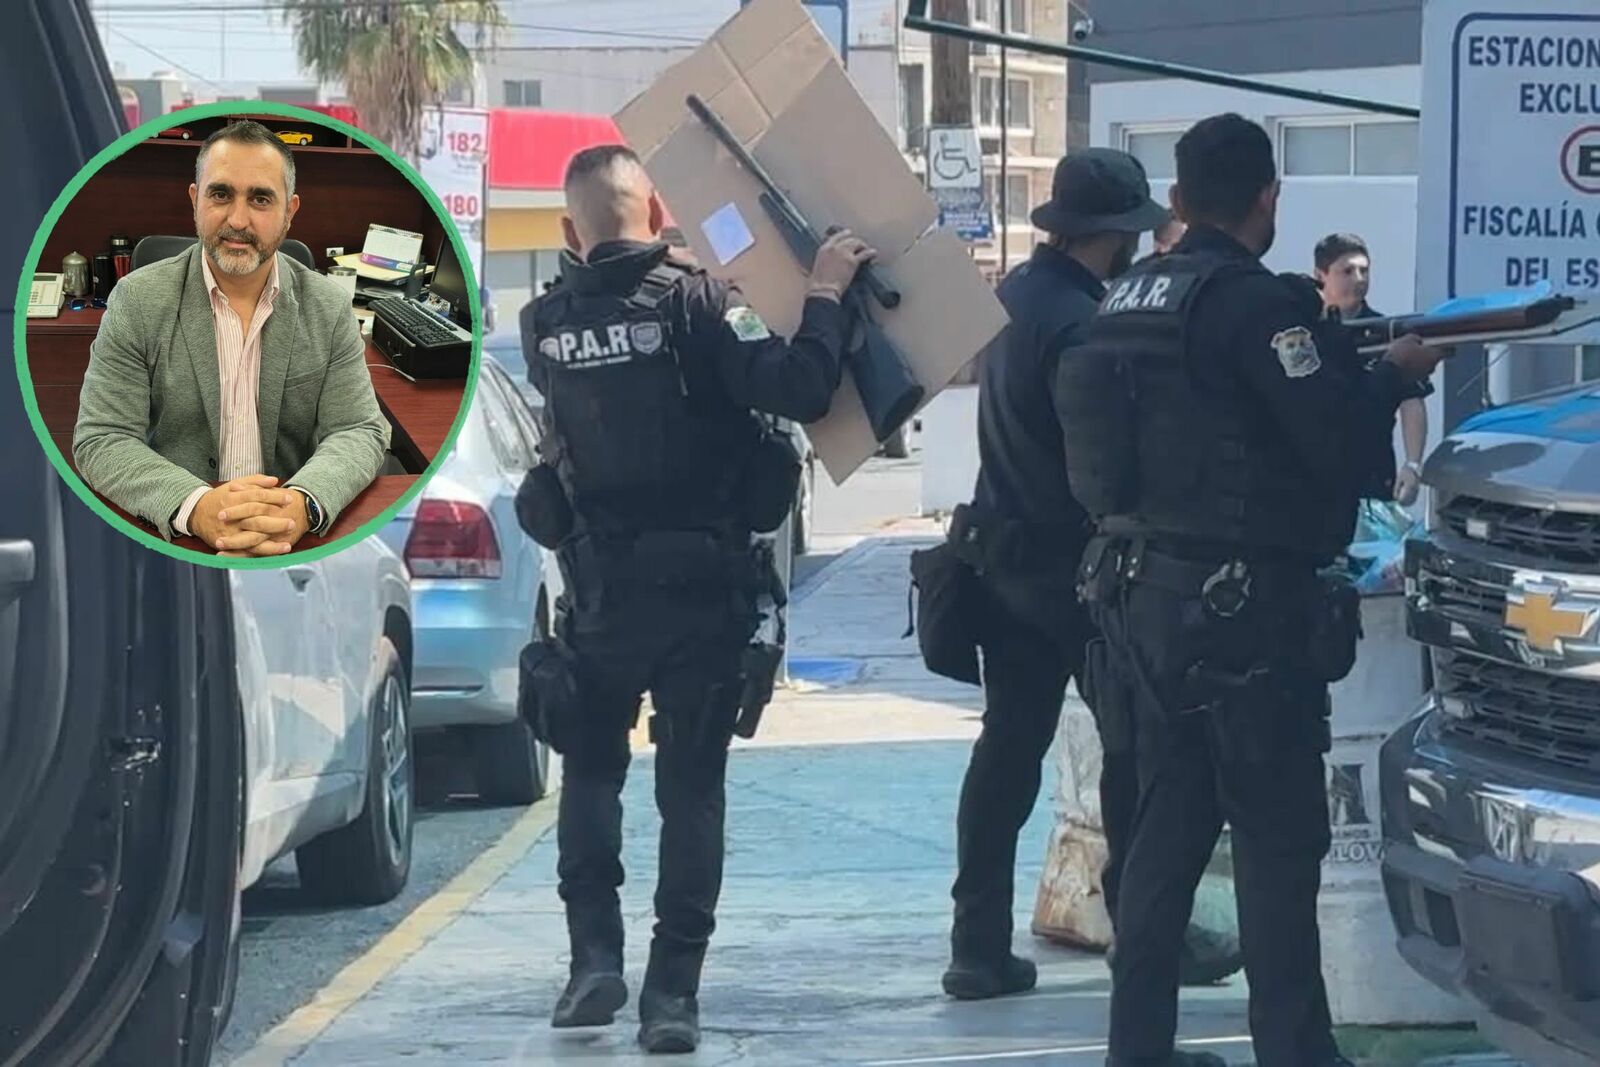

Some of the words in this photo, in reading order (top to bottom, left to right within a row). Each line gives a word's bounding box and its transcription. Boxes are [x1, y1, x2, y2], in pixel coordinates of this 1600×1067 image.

[448, 132, 482, 153] 182
[443, 194, 478, 216] 180
[1463, 201, 1586, 238] FISCALÍA
[1567, 258, 1599, 288] ES
